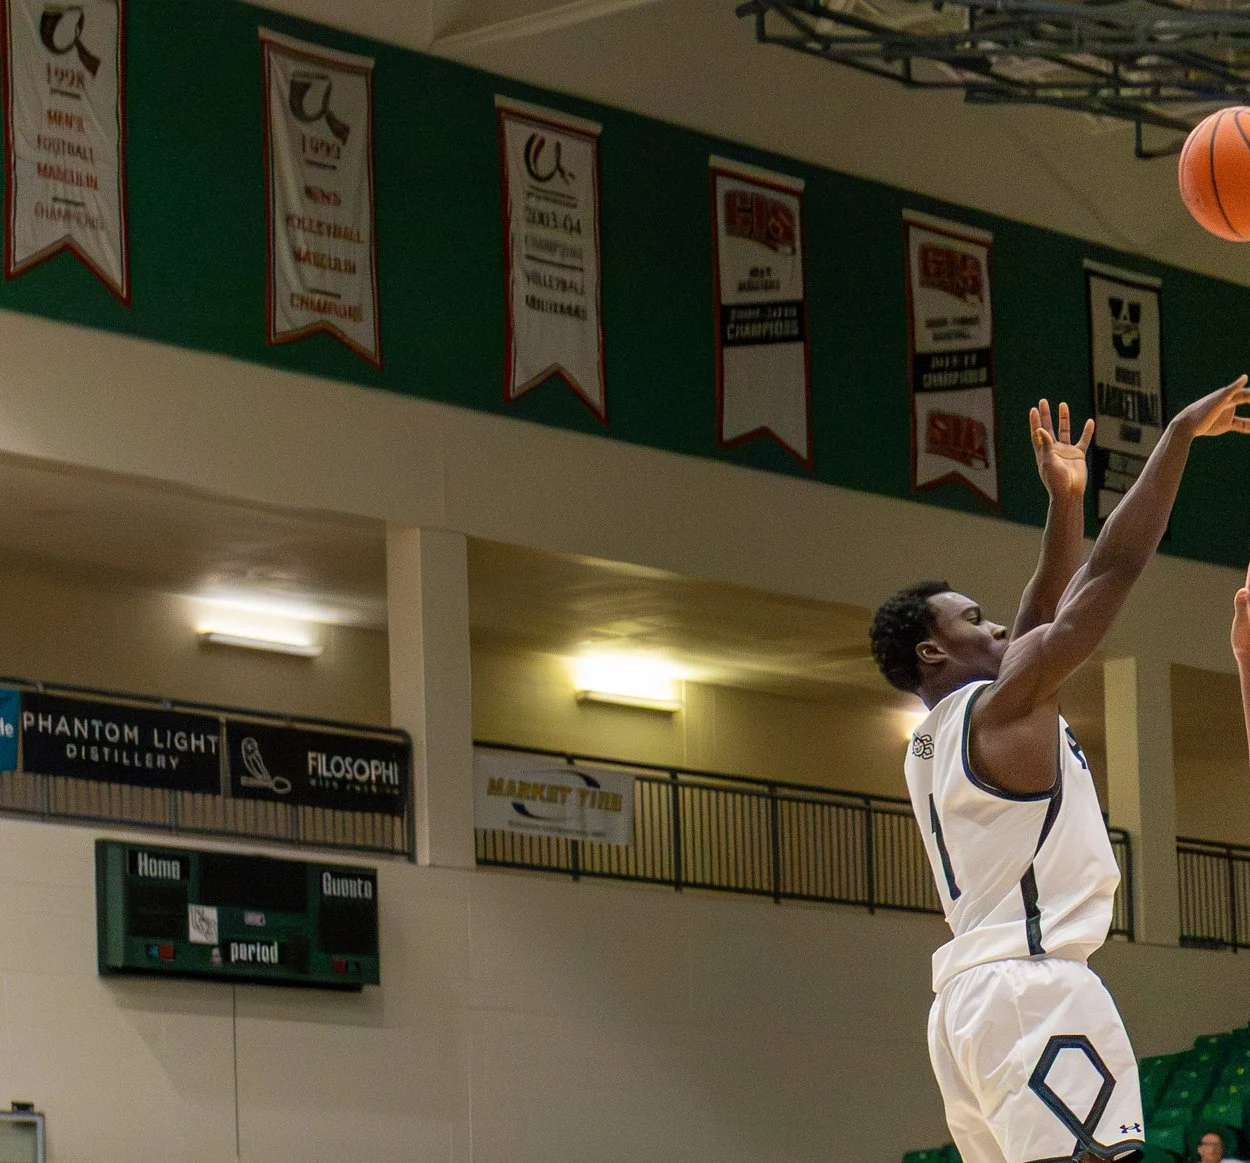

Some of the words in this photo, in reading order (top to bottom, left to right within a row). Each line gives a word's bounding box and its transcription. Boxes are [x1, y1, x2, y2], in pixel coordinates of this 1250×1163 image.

[23, 710, 140, 746] PHANTOM
[153, 727, 219, 755] LIGHT
[66, 743, 180, 771] DISTILLERY
[308, 751, 399, 785] FILOSOPHI
[137, 852, 181, 881] Home
[229, 940, 279, 965] period
